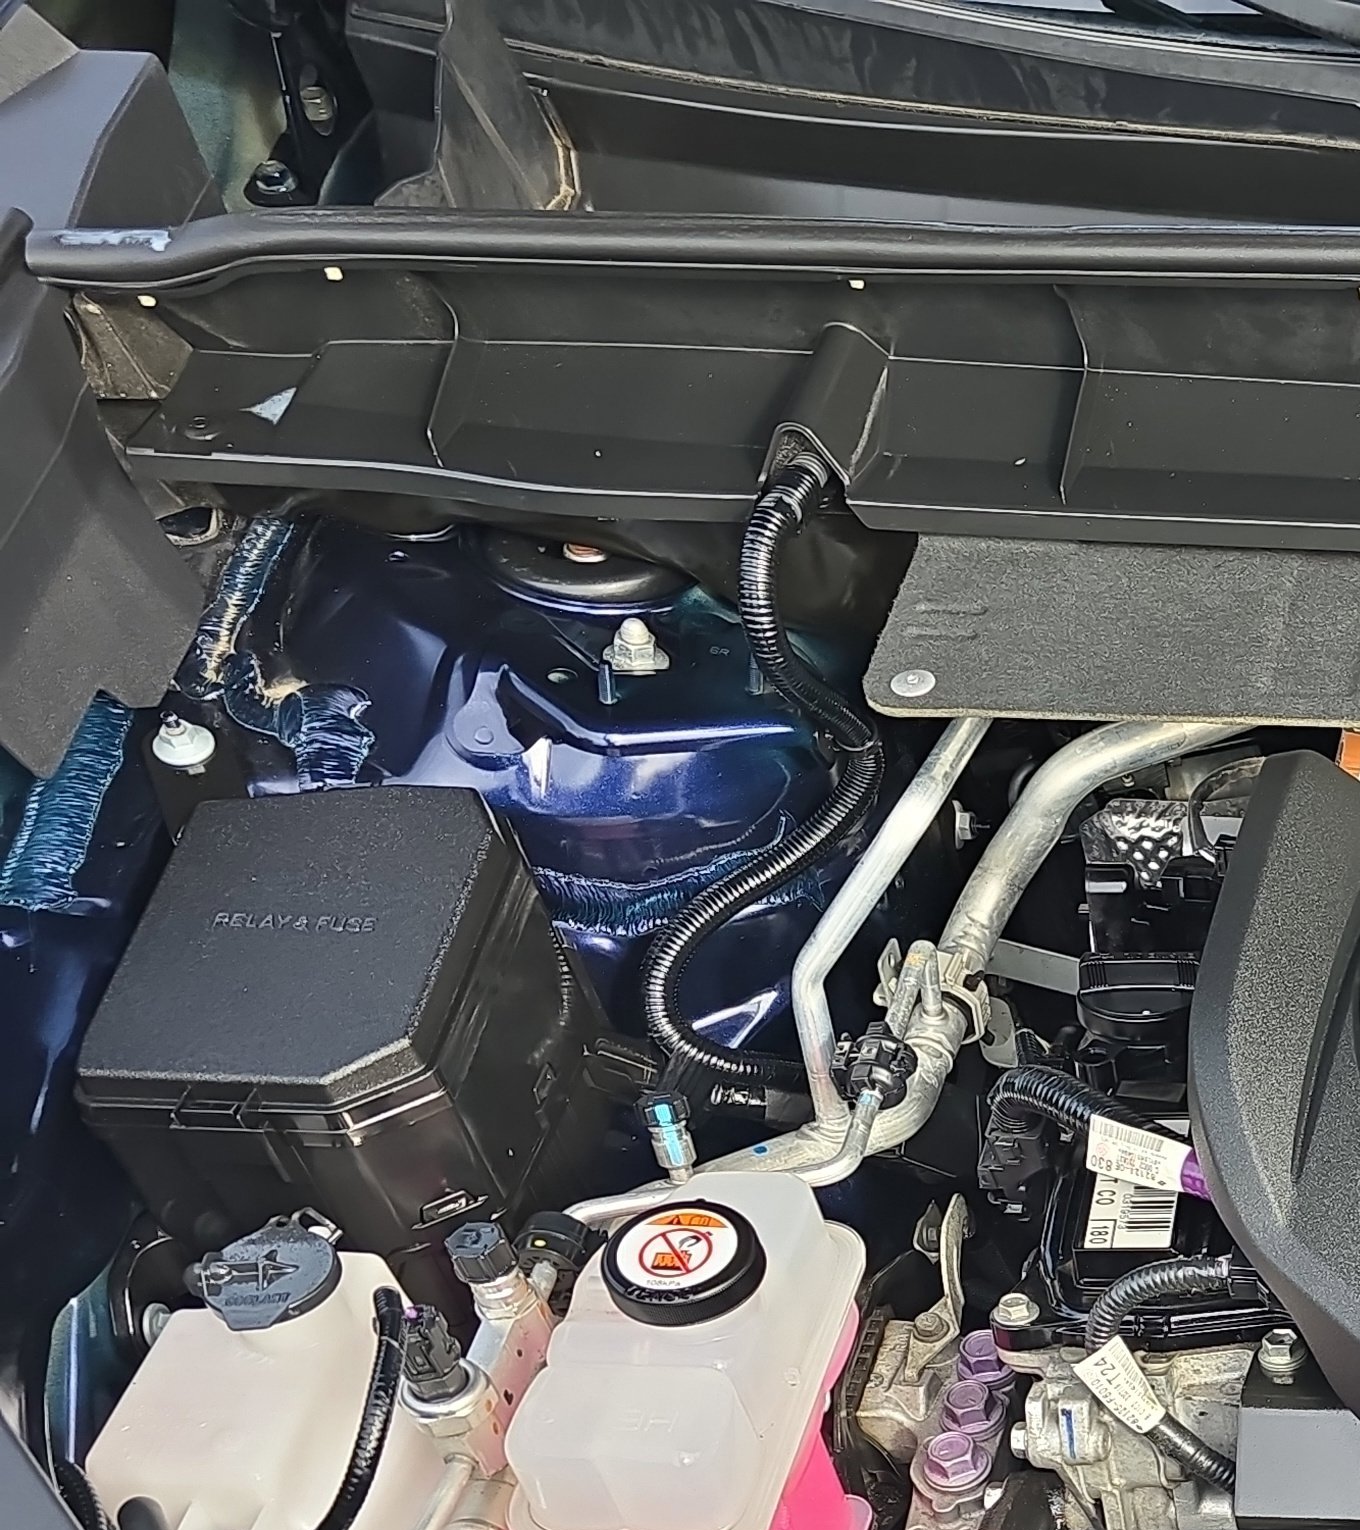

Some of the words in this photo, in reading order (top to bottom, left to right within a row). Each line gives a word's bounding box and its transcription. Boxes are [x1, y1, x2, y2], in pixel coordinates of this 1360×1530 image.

[212, 912, 292, 931] RELAY
[315, 915, 377, 933] FUSE
[1090, 1154, 1113, 1172] 830
[1088, 1225, 1110, 1244] 180
[1094, 1356, 1121, 1386] T24
